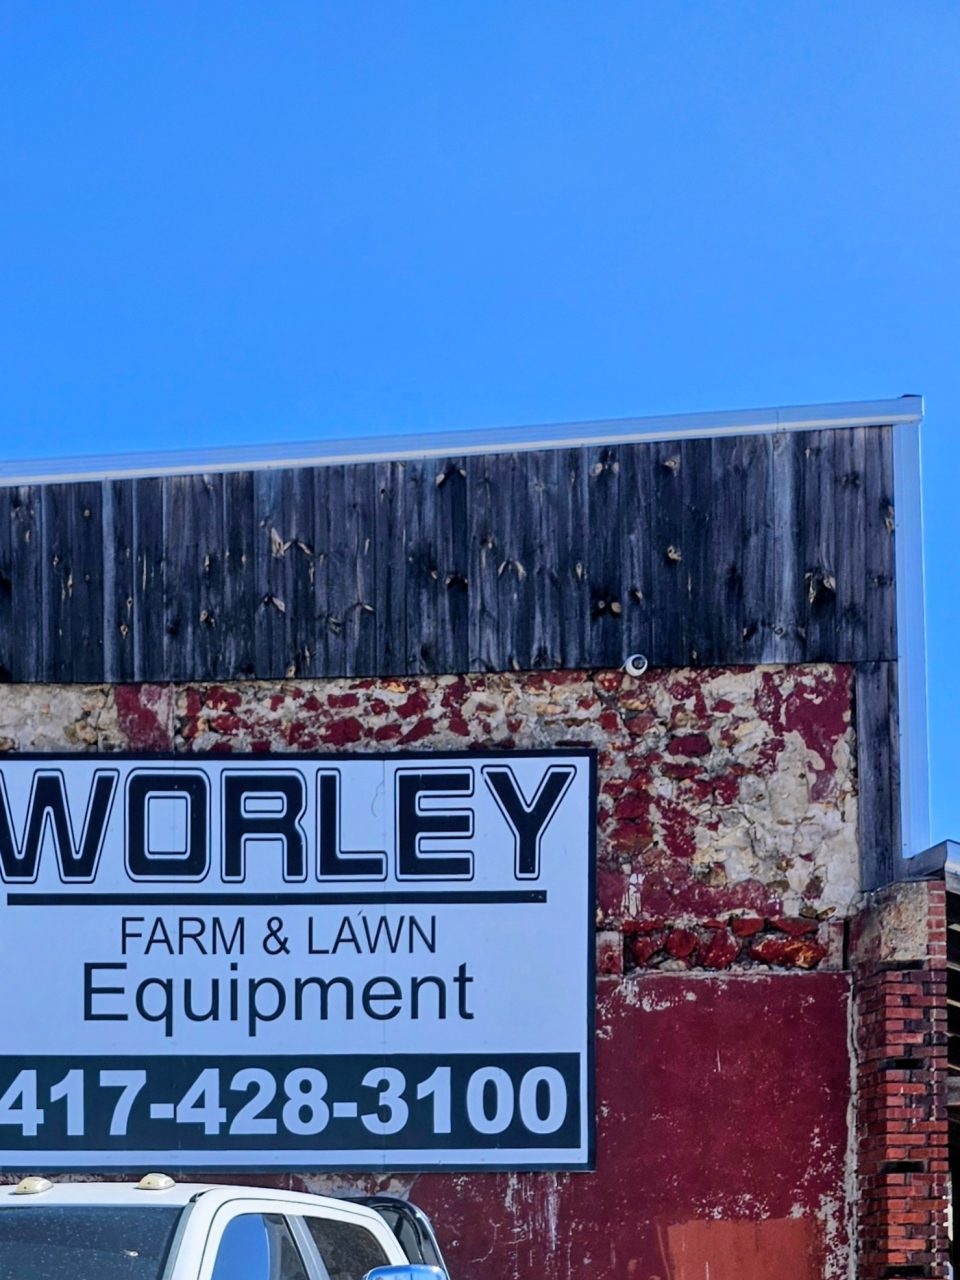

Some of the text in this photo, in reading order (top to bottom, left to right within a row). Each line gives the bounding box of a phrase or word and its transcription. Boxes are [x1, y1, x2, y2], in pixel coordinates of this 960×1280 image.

[121, 915, 437, 955] FARM & LAWN
[83, 961, 474, 1037] Equipment
